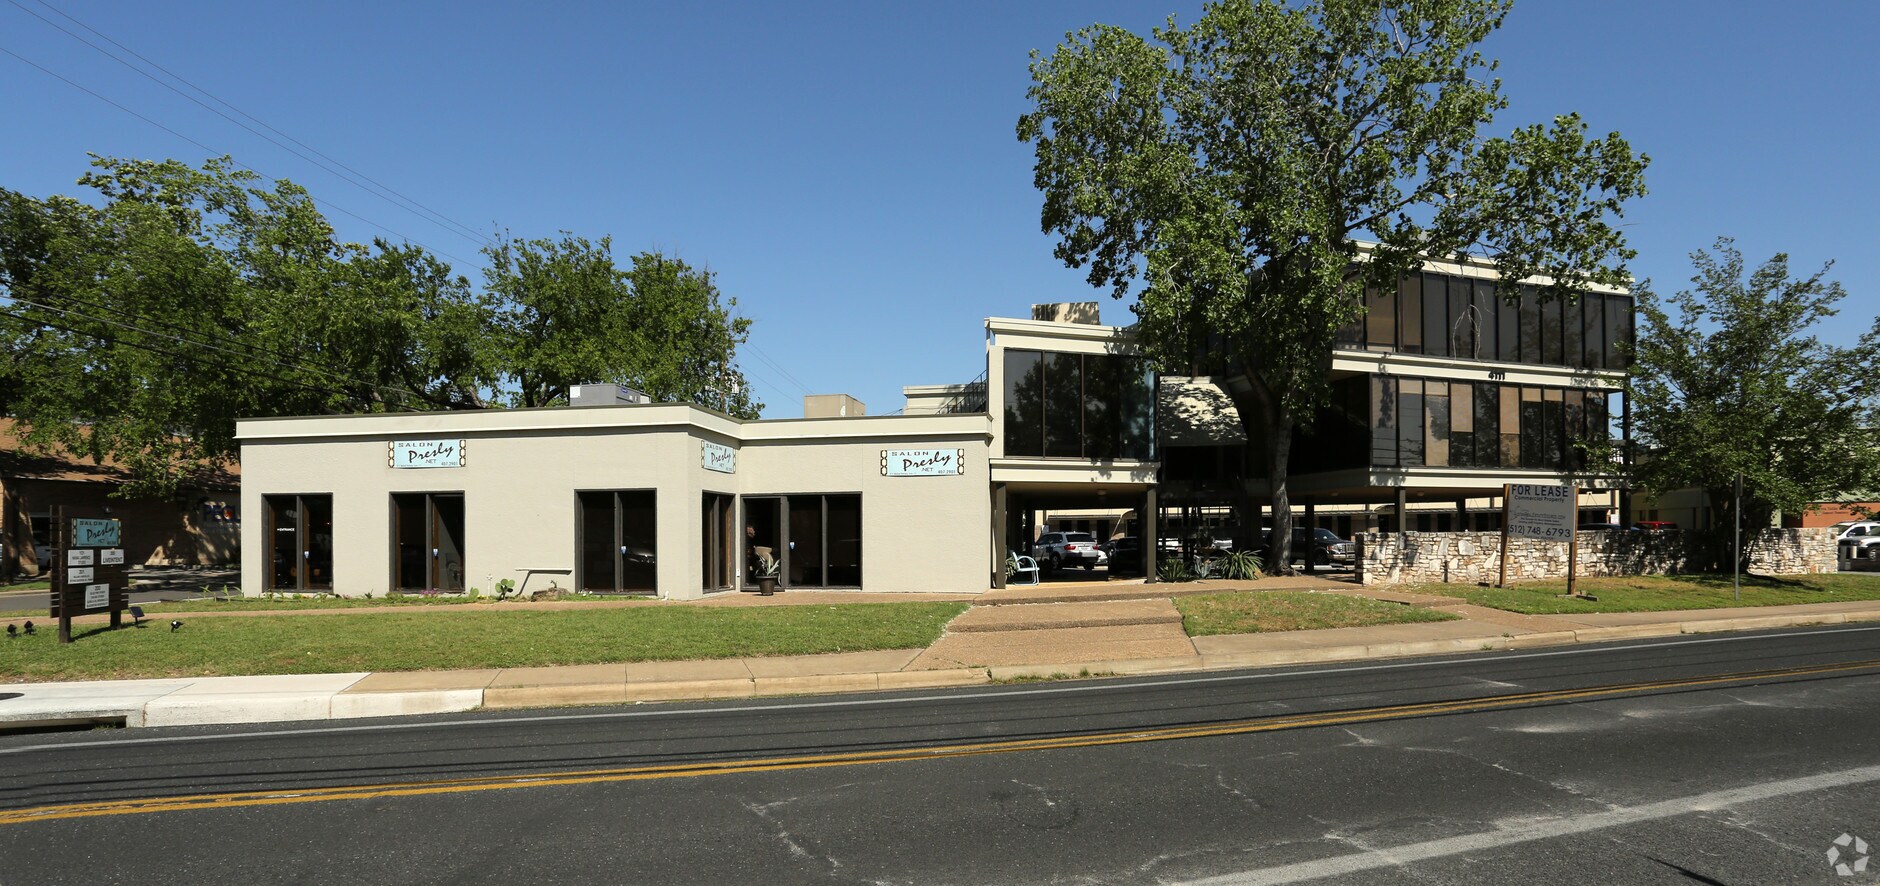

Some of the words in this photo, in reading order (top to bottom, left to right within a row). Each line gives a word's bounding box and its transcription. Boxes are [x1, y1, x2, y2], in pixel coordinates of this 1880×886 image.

[1488, 371, 1505, 380] 4111
[408, 442, 454, 463] Presly
[706, 443, 723, 451] SALON
[711, 448, 731, 465] Presly
[903, 451, 952, 471] Presly
[1511, 485, 1531, 495] FOR
[1535, 485, 1569, 497] LEASE
[86, 522, 115, 542] Presly
[1507, 524, 1525, 535] (512)
